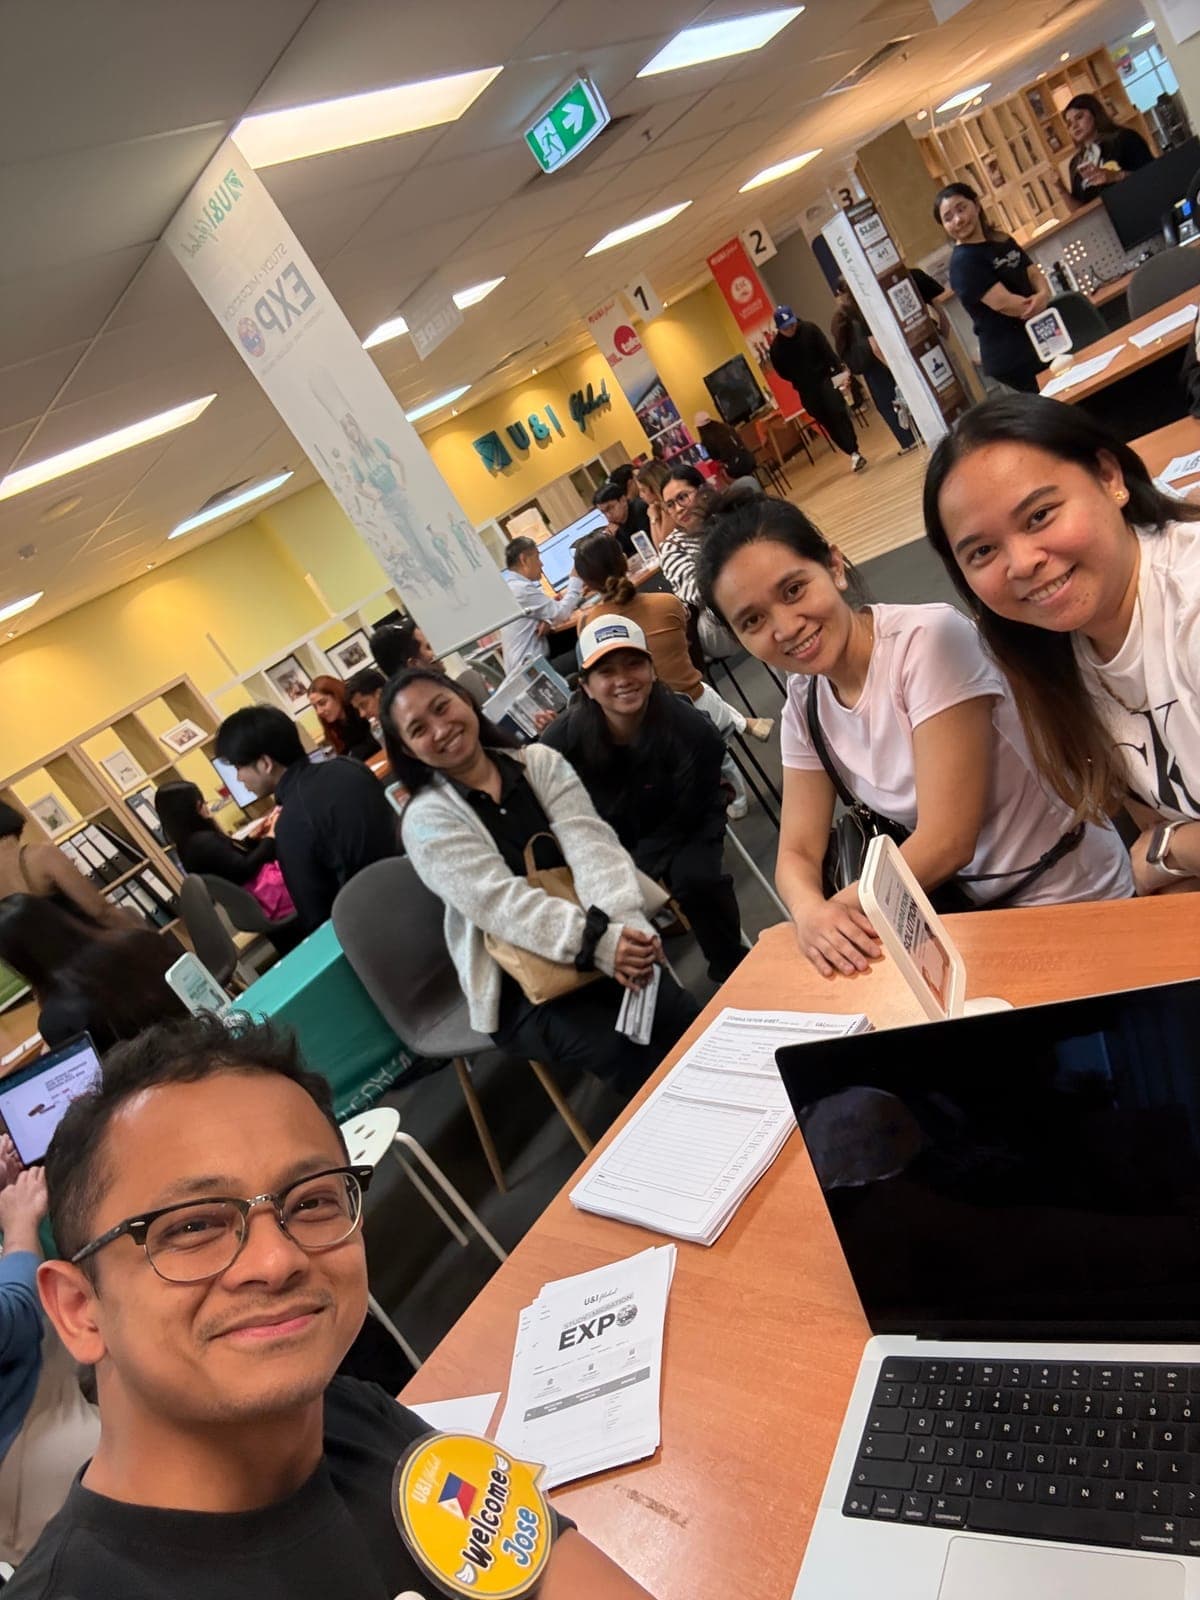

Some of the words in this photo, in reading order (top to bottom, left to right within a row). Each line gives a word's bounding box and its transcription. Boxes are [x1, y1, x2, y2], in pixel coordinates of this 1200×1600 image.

[838, 187, 854, 207] 3
[749, 229, 768, 255] 2
[633, 285, 650, 311] 1
[505, 404, 562, 450] U&I
[460, 1468, 509, 1570] Welcome
[501, 1505, 540, 1566] Jose
